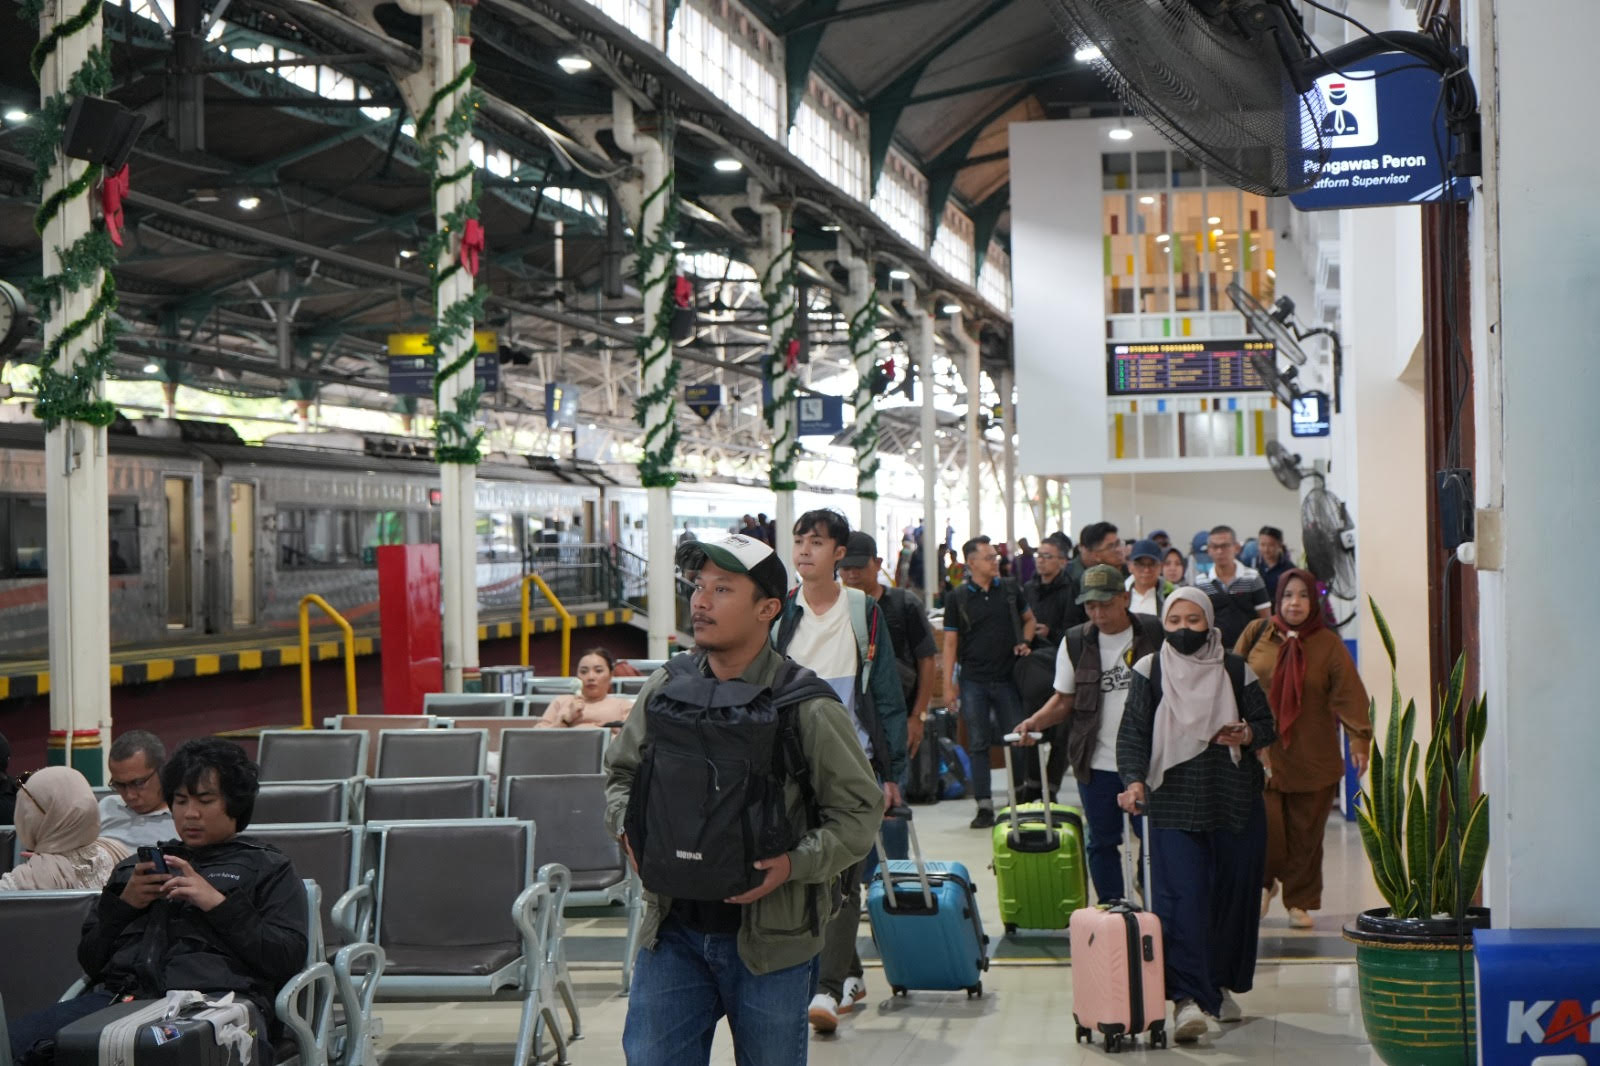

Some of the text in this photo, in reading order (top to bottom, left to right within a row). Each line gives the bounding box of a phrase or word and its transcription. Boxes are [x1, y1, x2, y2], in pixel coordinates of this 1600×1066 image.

[1303, 154, 1426, 175] Pengawas Peron
[1312, 173, 1411, 189] atform Supervisor
